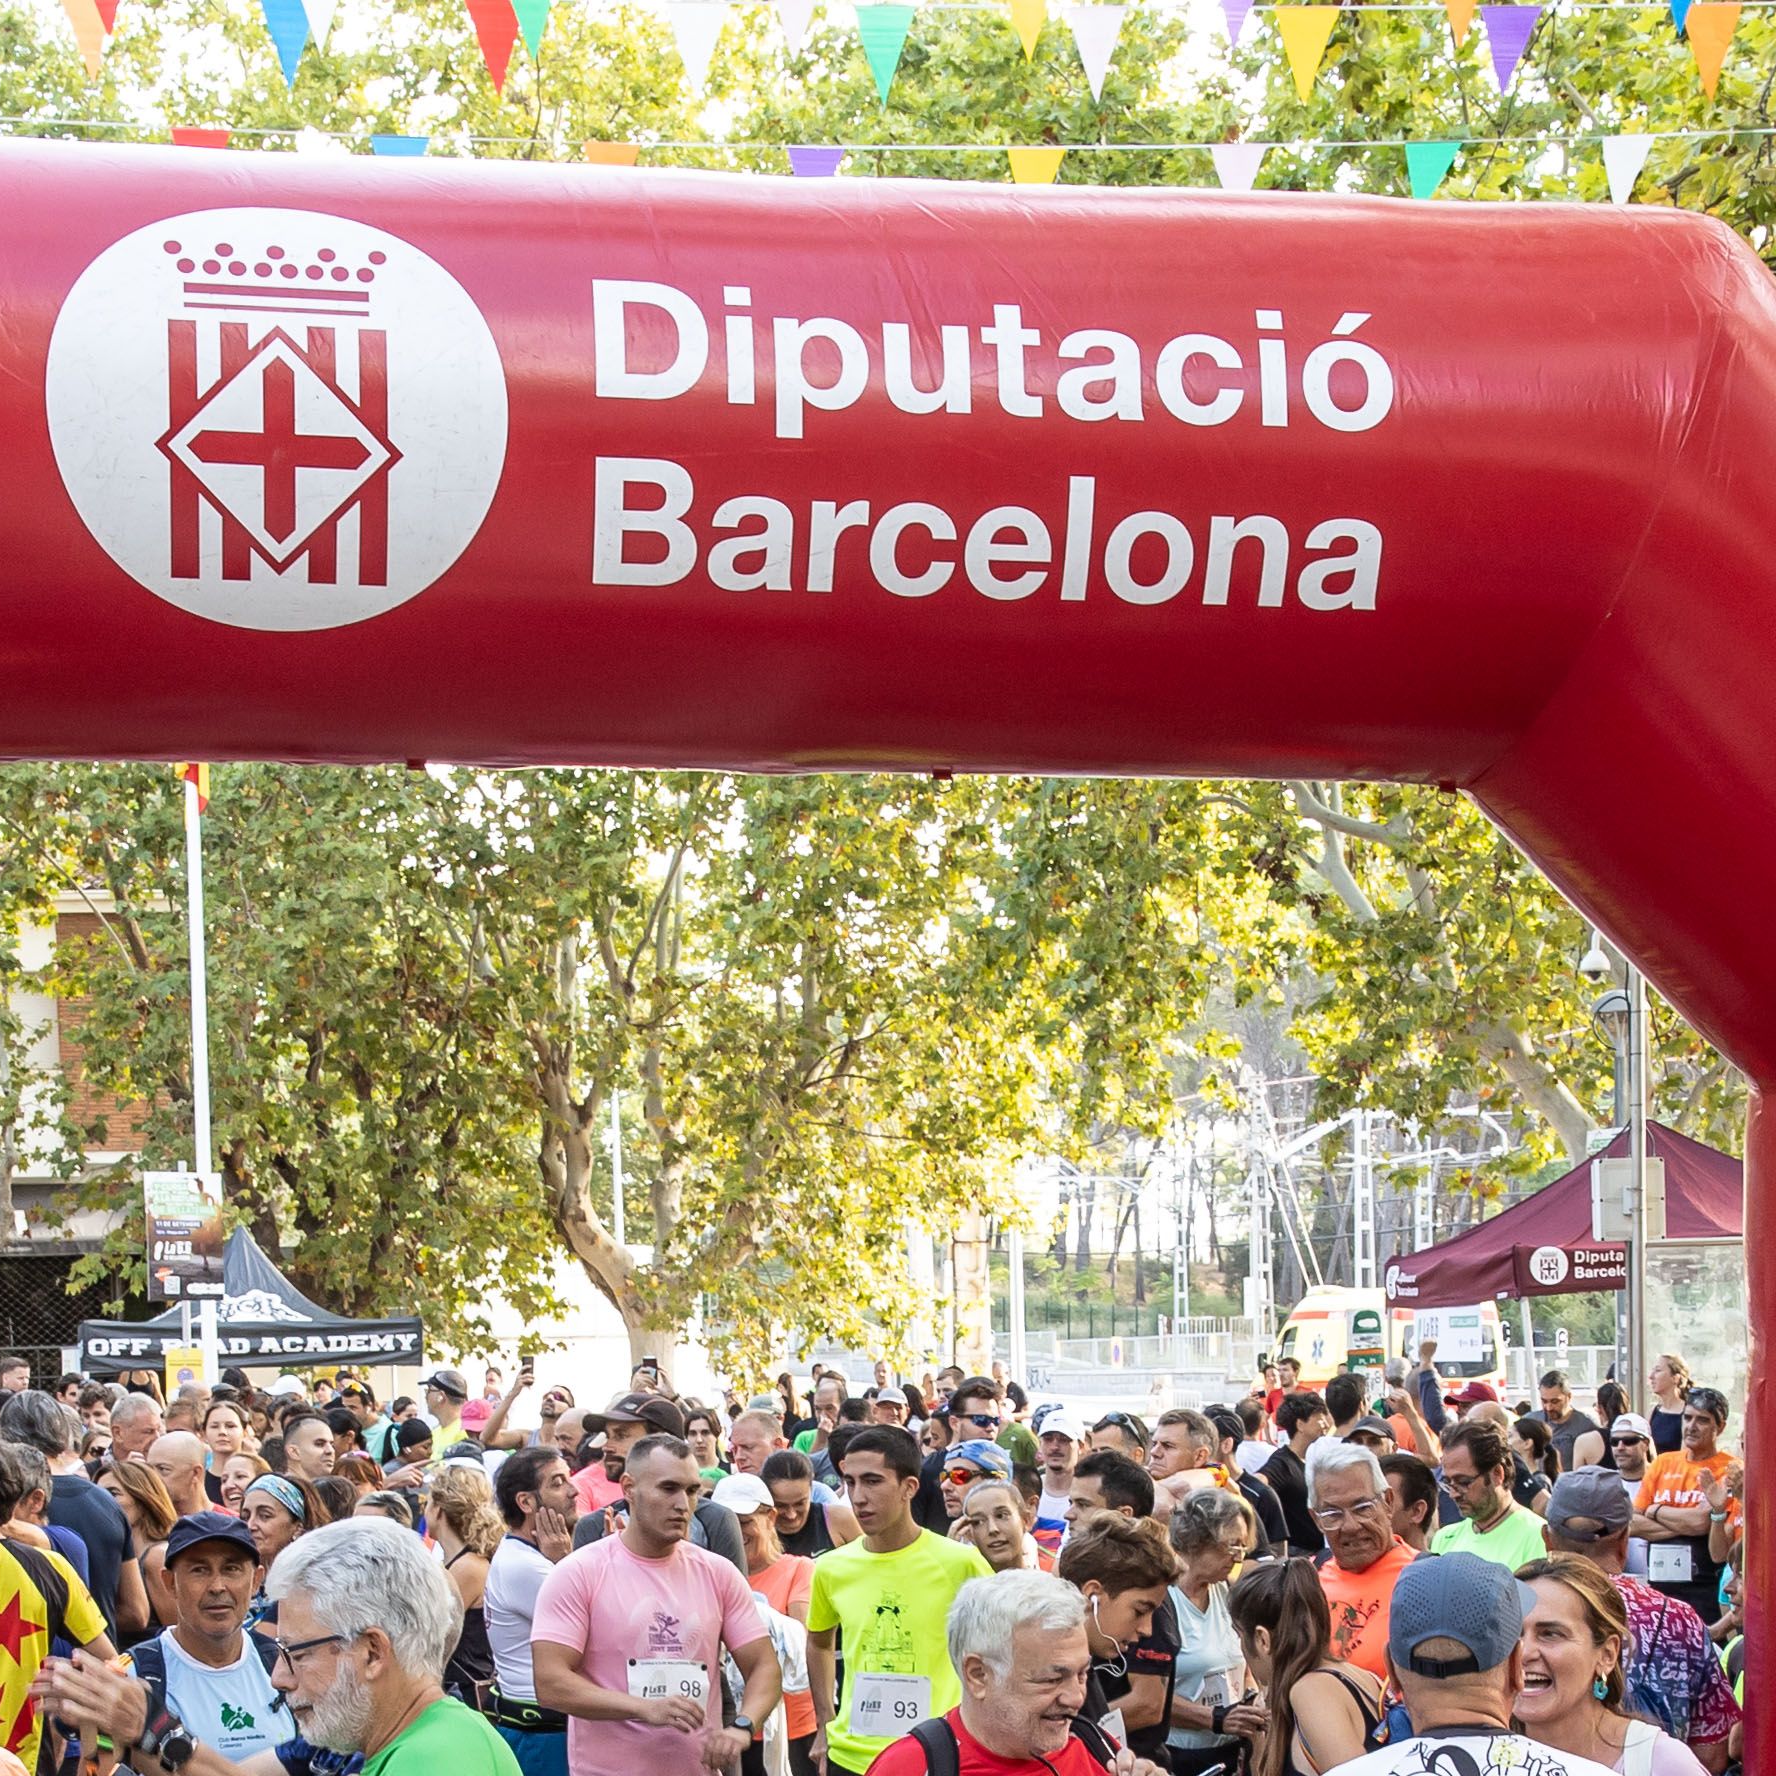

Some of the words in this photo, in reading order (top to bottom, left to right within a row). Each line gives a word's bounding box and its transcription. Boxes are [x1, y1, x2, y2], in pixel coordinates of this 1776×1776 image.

[591, 277, 1395, 439] Diputació
[591, 456, 1383, 612] Barcelona
[1573, 1250, 1626, 1266] Diputa
[1573, 1265, 1627, 1279] Barcelo
[86, 1337, 152, 1357] OFF
[257, 1332, 418, 1354] ACADEMY
[680, 1679, 702, 1699] 98
[893, 1700, 919, 1720] 93
